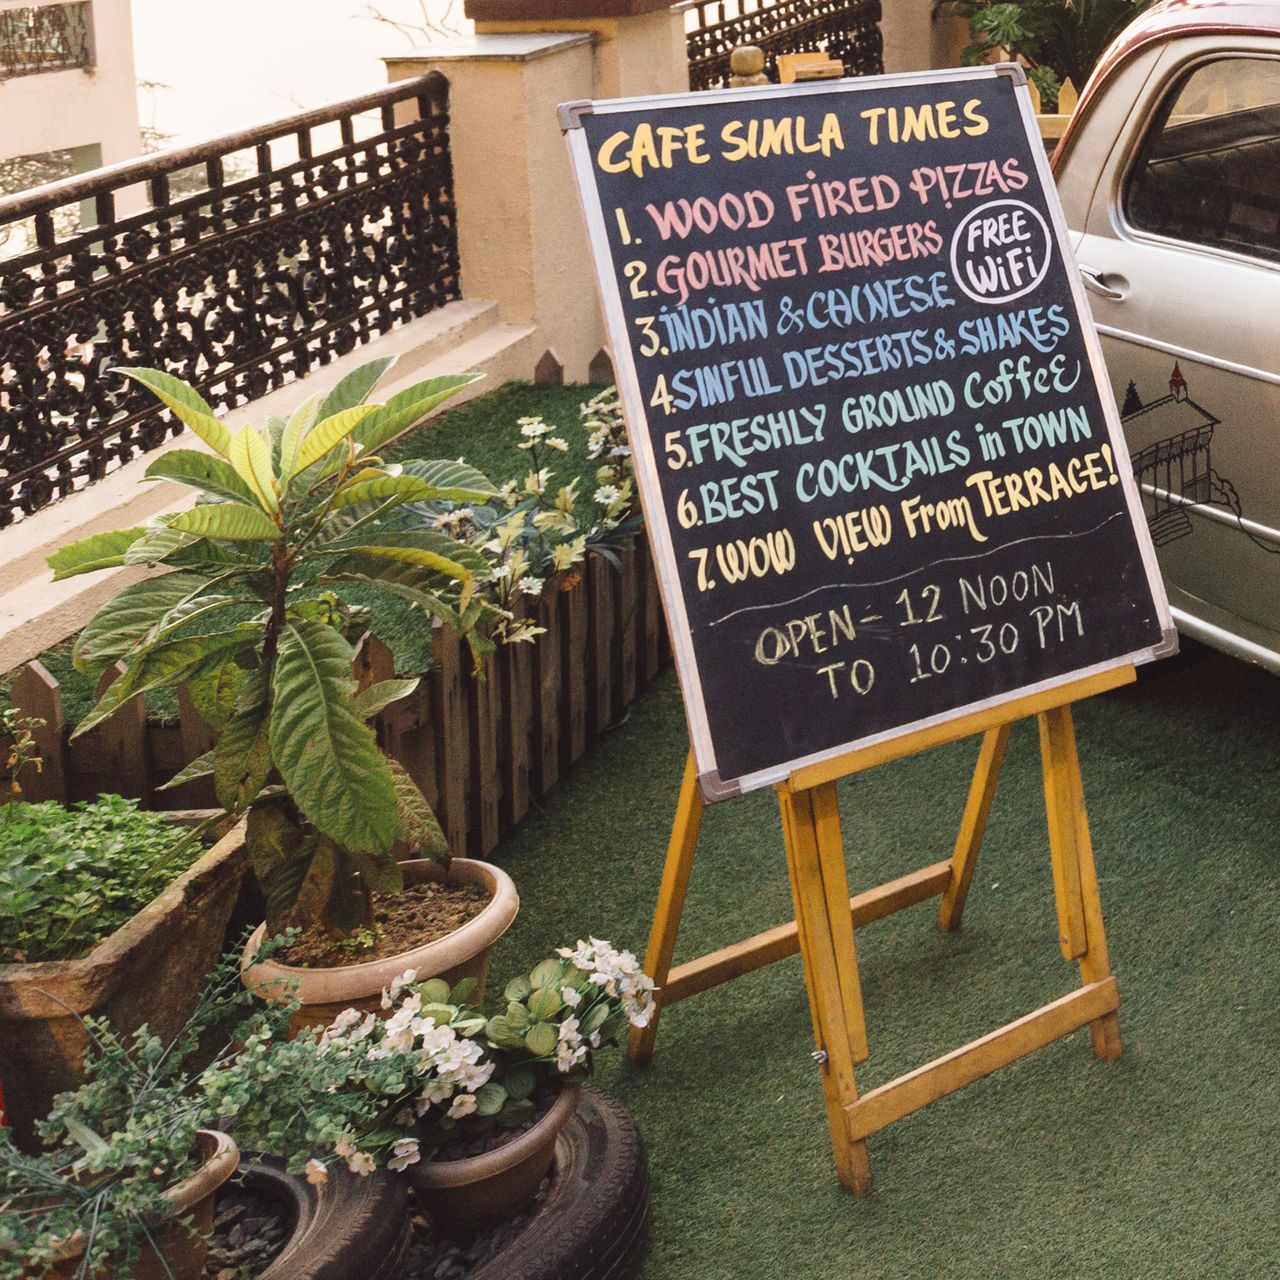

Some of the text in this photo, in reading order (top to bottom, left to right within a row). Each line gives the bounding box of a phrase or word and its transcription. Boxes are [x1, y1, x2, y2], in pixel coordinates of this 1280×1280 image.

[597, 99, 990, 177] CAFE SIMLA TIMES
[646, 190, 775, 241] WOOD
[910, 157, 1029, 209] PIZZAS
[967, 210, 1032, 252] FREE
[656, 237, 808, 306] GOURMET
[818, 221, 944, 273] BURGERS
[672, 357, 783, 411] SINFUL
[958, 304, 1070, 356] SHAKES
[686, 403, 827, 468] FRESHLY
[842, 379, 955, 434] GROUND
[699, 469, 780, 525] BEST
[795, 428, 972, 504] COCKTAILS
[976, 423, 1003, 462] in
[1002, 405, 1093, 455] TOWN
[715, 528, 796, 584] WOW
[813, 504, 892, 565] VIEW
[901, 495, 989, 543] From
[965, 442, 1119, 519] TERRACE!
[896, 584, 943, 627] 12
[959, 562, 1055, 614] NOON
[816, 601, 1085, 699] TO 10:30 PM
